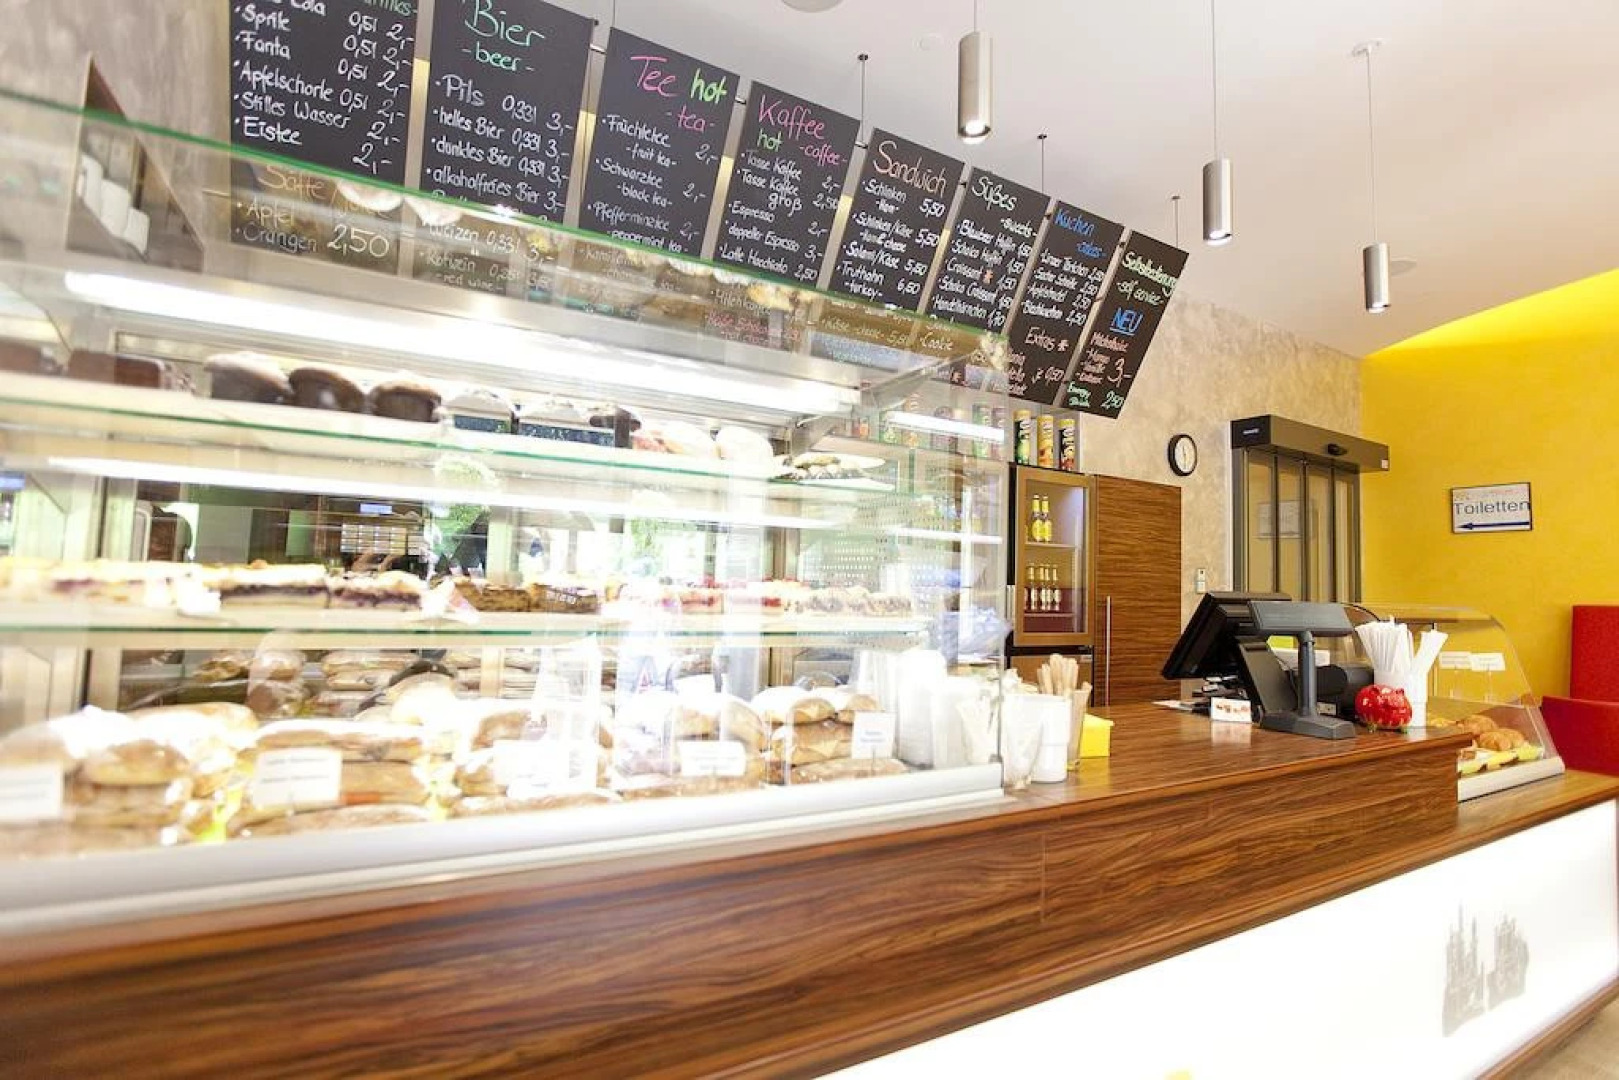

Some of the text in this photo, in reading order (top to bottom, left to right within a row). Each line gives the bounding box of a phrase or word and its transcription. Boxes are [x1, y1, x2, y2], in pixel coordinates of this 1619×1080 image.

[241, 4, 291, 31] Sprite
[464, 0, 546, 46] Bier
[240, 30, 291, 60] Fanta
[240, 60, 333, 101] Apfelschorle
[442, 74, 485, 107] Pils
[631, 56, 727, 103] Tee hot
[240, 91, 285, 117] Stilles
[294, 101, 350, 129] Wasser
[438, 106, 472, 131] helles
[475, 117, 505, 139] Bier
[759, 95, 825, 140] Kaffee
[244, 116, 302, 145] Eistee
[607, 114, 671, 148] Früchtetee
[757, 128, 783, 151] hot
[436, 136, 484, 162] dunkles
[487, 148, 515, 167] Bier
[747, 150, 771, 169] Tasse
[773, 158, 802, 180] Kaffee
[432, 166, 512, 197] alkoholfreies
[516, 182, 540, 203] Bier
[601, 158, 663, 189] Schwarztee
[742, 169, 799, 197] Tasse Kaffee
[873, 141, 946, 198] Sandwich
[768, 192, 802, 217] groß
[865, 179, 945, 217] Schinken 5,50
[971, 176, 1018, 211] Süßes
[246, 196, 295, 228] Apfel
[731, 202, 776, 223] Espresso
[1055, 208, 1095, 236] Kuchen
[243, 221, 390, 257] Orangen 2,50
[765, 231, 801, 253] Espresso
[915, 229, 940, 247] 5,50
[720, 243, 744, 262] Latte
[794, 263, 818, 281] 2,50
[842, 260, 921, 295] Truthahn 6,50
[904, 259, 928, 276] 5,50
[1112, 306, 1144, 333] NEU
[1100, 390, 1125, 411] 2,50
[1454, 500, 1531, 515] Toiletten
